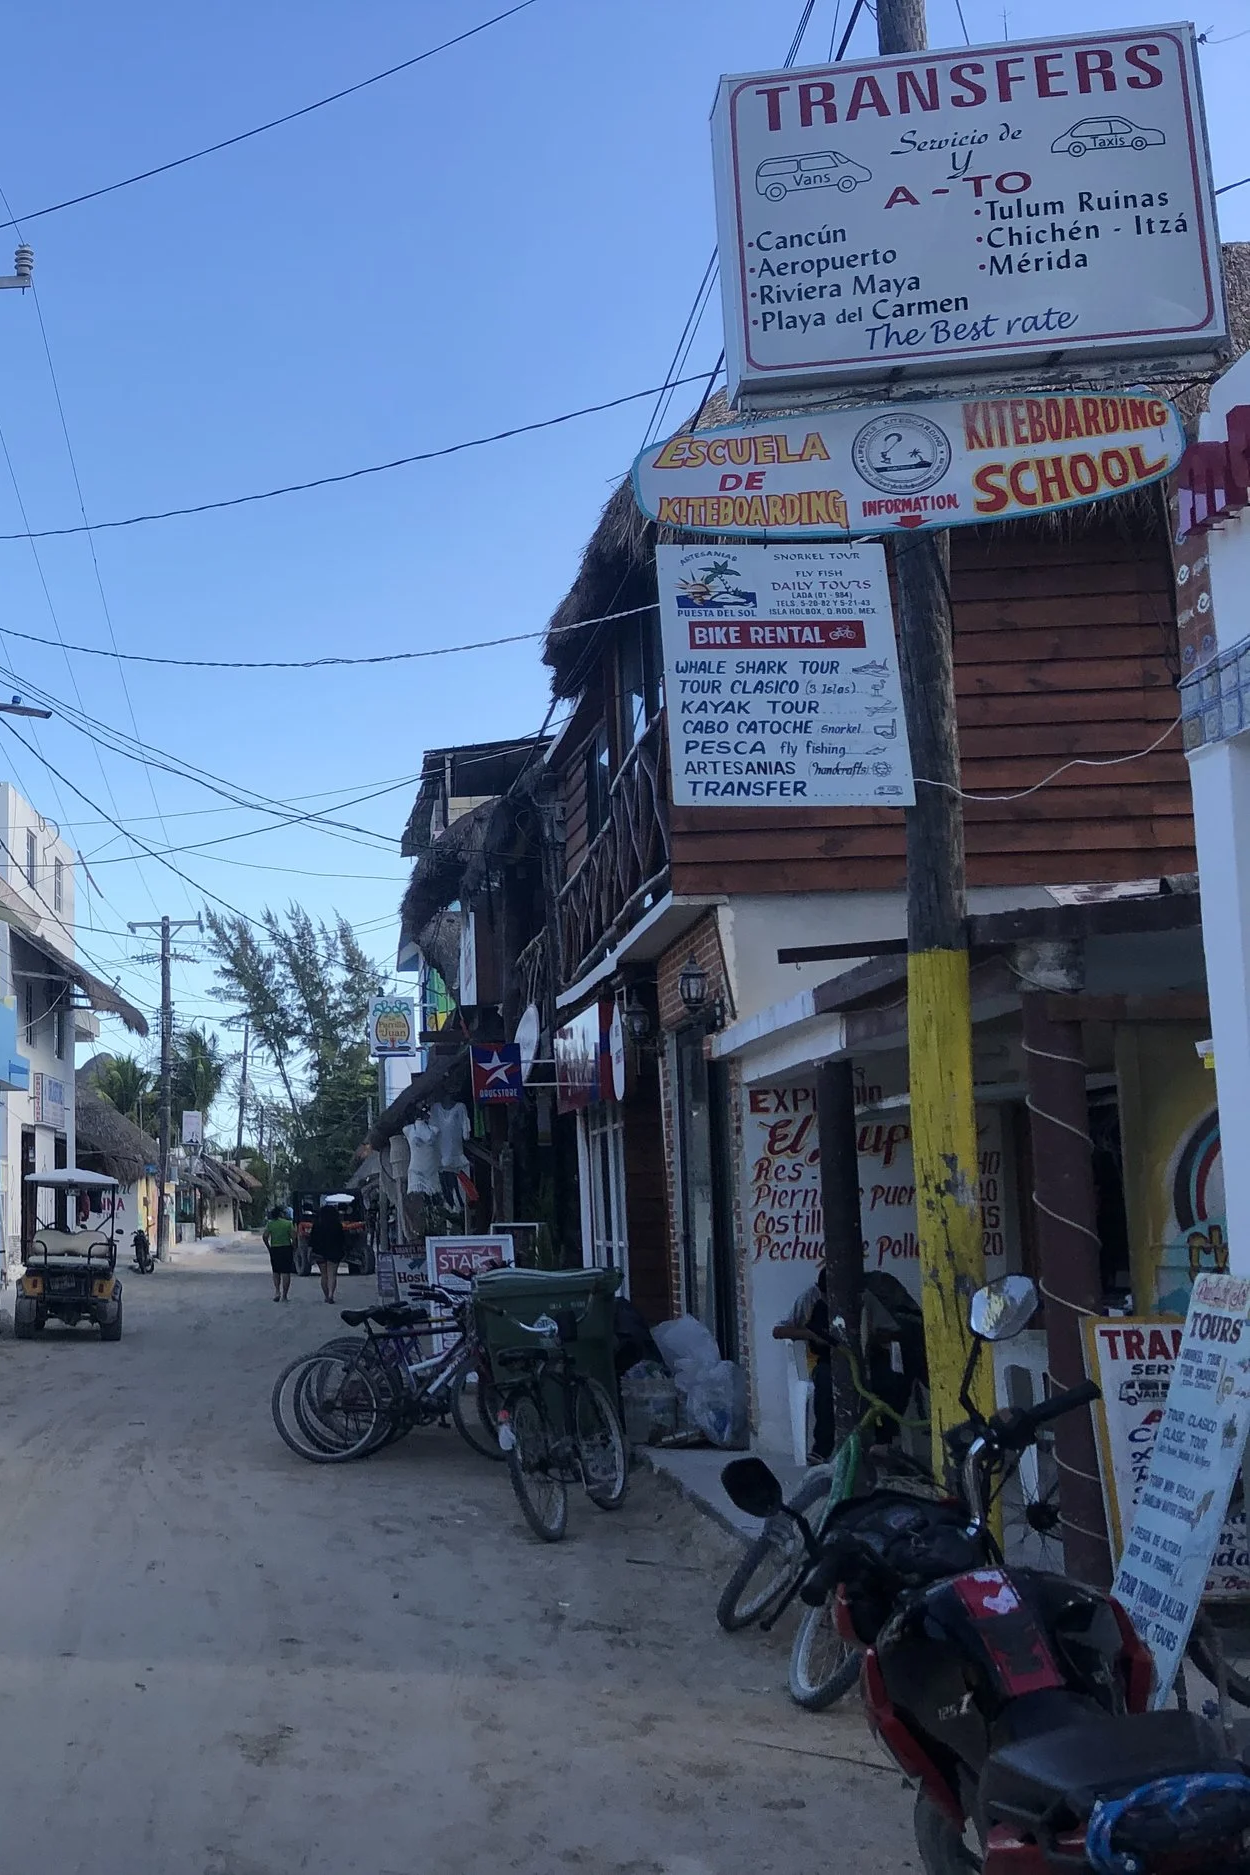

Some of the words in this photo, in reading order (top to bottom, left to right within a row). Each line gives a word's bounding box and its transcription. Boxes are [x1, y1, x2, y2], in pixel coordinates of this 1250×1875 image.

[755, 44, 1165, 131] TRANSFERS
[889, 130, 990, 156] Servicio
[998, 124, 1023, 142] de
[1090, 134, 1126, 149] Taxis
[793, 171, 831, 186] Vans
[964, 171, 1032, 198] TO
[987, 196, 1065, 221] Tulum
[1078, 189, 1169, 214] Ruinas
[755, 226, 847, 251] Cancún
[987, 221, 1101, 248] Chichén
[1135, 213, 1188, 237] Itzá
[757, 247, 897, 278] Aeropuerto
[988, 250, 1089, 276] Mérida
[760, 281, 842, 305] Riviera
[853, 274, 921, 301] Maya
[762, 310, 826, 334] Playa
[836, 305, 863, 324] del
[872, 295, 969, 320] Carmen
[865, 325, 926, 351] The
[931, 314, 995, 344] Best
[1006, 308, 1079, 334] rate
[962, 397, 1168, 452] KITEBOARDING
[653, 432, 832, 468] ESCUELA
[719, 471, 766, 491] DE
[973, 444, 1168, 515] SCHOOL
[656, 491, 847, 529] KITEBOARDING
[862, 493, 960, 517] INFORMATION
[680, 551, 737, 566] ARTESANIAS
[773, 553, 825, 561] SNORKEL
[771, 582, 814, 591] DAILY
[819, 580, 871, 590] TOURS
[678, 609, 715, 617] PUESTA
[717, 609, 736, 617] DEL
[738, 608, 757, 617] SOL
[694, 627, 741, 644] BIKE
[751, 627, 825, 644] RENTAL
[676, 661, 726, 674] WHALE
[736, 661, 787, 674] SHARK
[800, 661, 839, 674] TOUR
[680, 680, 722, 694] TOUR
[731, 680, 799, 694] CLASICO
[681, 701, 751, 714] KAYAK
[767, 701, 819, 714] TOUR
[683, 721, 728, 734] CABO
[737, 721, 813, 734] CATOCHE
[685, 741, 766, 754] PESCA
[781, 742, 797, 757] fly
[806, 743, 845, 757] fishing
[685, 761, 795, 774] ARTESANIAS
[689, 781, 808, 796] TRANSFER
[382, 1028, 406, 1037] Juan
[752, 1157, 804, 1184] Res
[751, 1184, 822, 1210] Piern
[753, 1209, 822, 1234] Costill
[439, 1254, 482, 1270] STAR
[1189, 1312, 1244, 1345] TOURS
